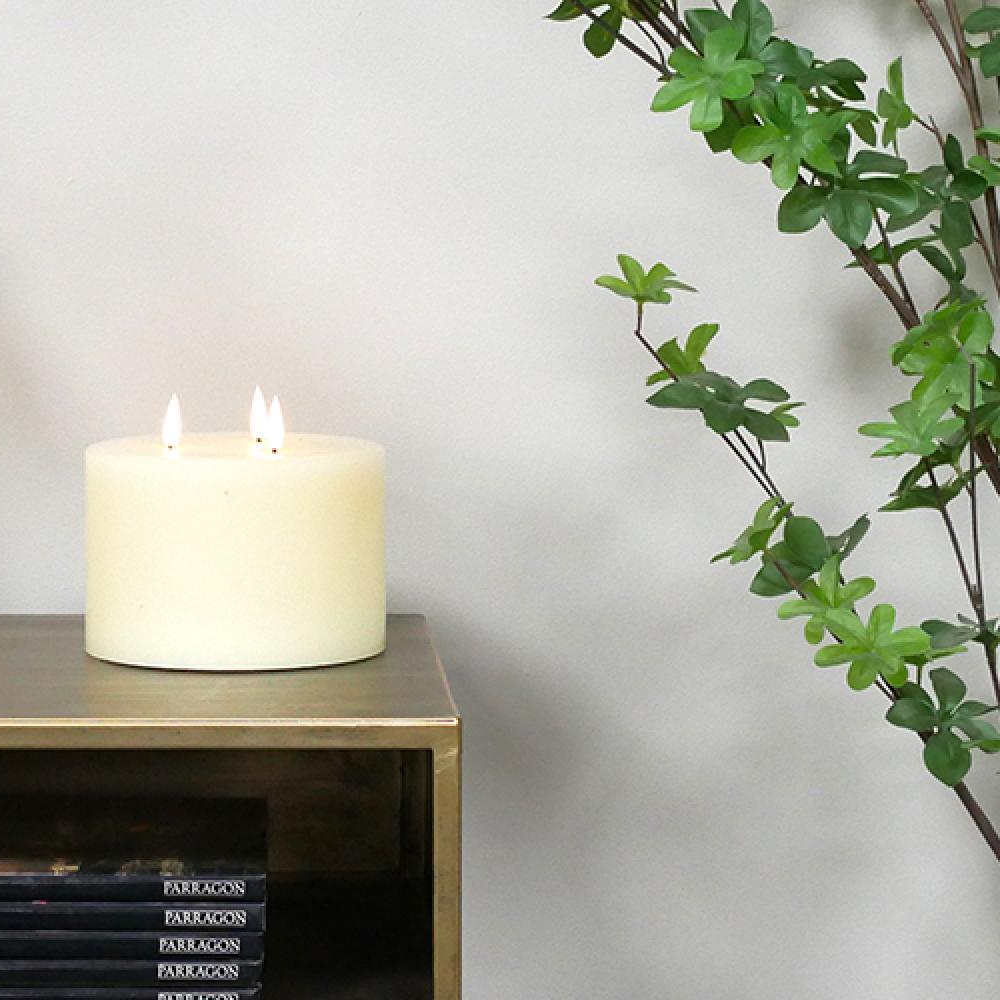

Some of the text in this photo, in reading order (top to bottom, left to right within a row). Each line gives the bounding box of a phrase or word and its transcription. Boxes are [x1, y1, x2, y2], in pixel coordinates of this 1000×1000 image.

[163, 880, 245, 896] PARRAGON
[165, 910, 247, 926] PARRAGON
[159, 938, 240, 953] PARRAGON
[157, 963, 239, 979] PARRAGON
